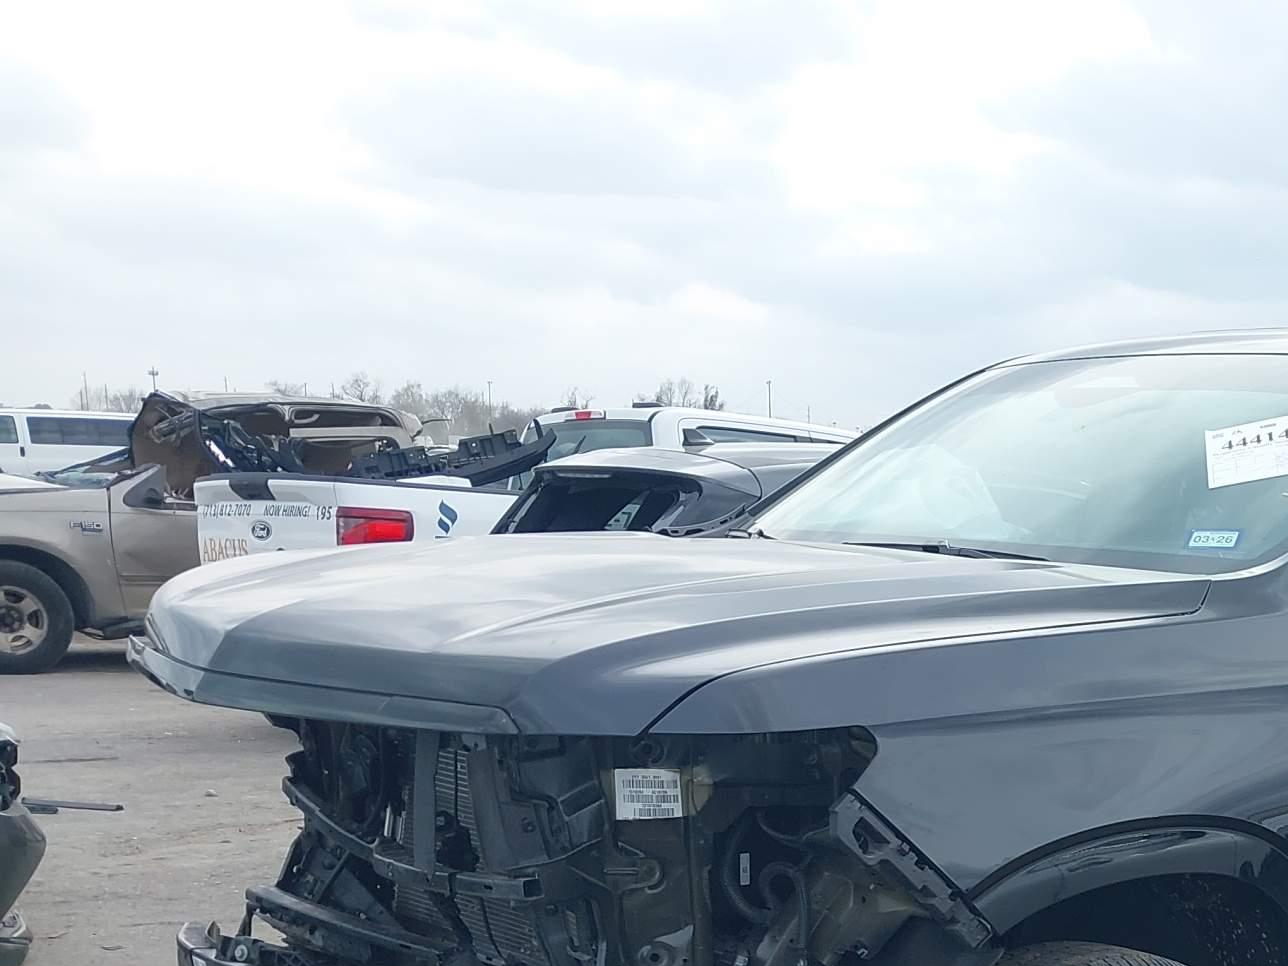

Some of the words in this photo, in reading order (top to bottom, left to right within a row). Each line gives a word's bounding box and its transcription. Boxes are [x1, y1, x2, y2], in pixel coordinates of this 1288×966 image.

[264, 504, 282, 517] NOW
[282, 504, 311, 518] HIRING!
[316, 506, 332, 520] 195
